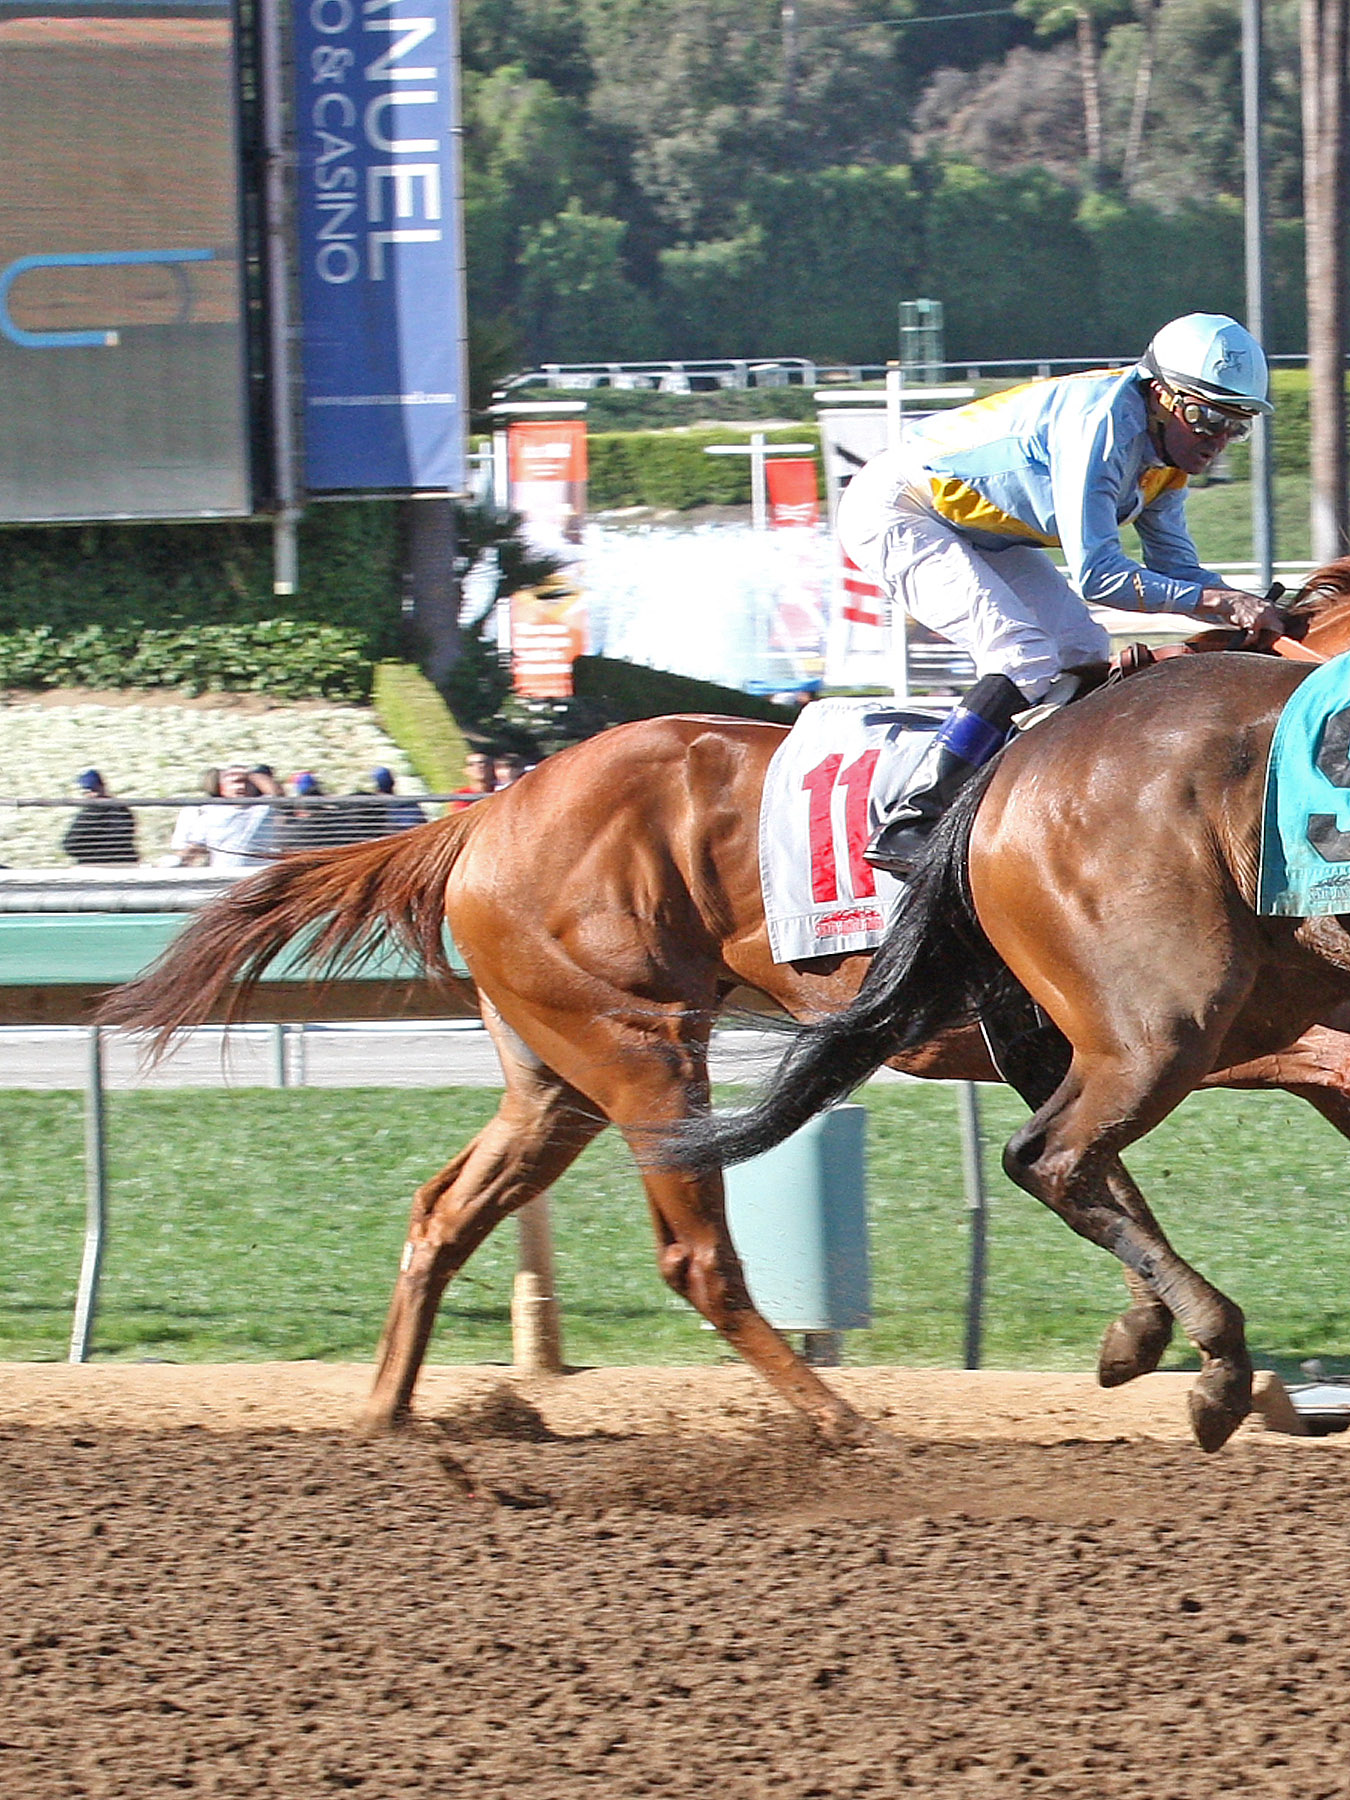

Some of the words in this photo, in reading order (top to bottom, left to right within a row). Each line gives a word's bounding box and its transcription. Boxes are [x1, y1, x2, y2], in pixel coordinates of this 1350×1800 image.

[311, 45, 356, 84] &
[311, 92, 360, 285] CASINO
[801, 748, 882, 904] 11
